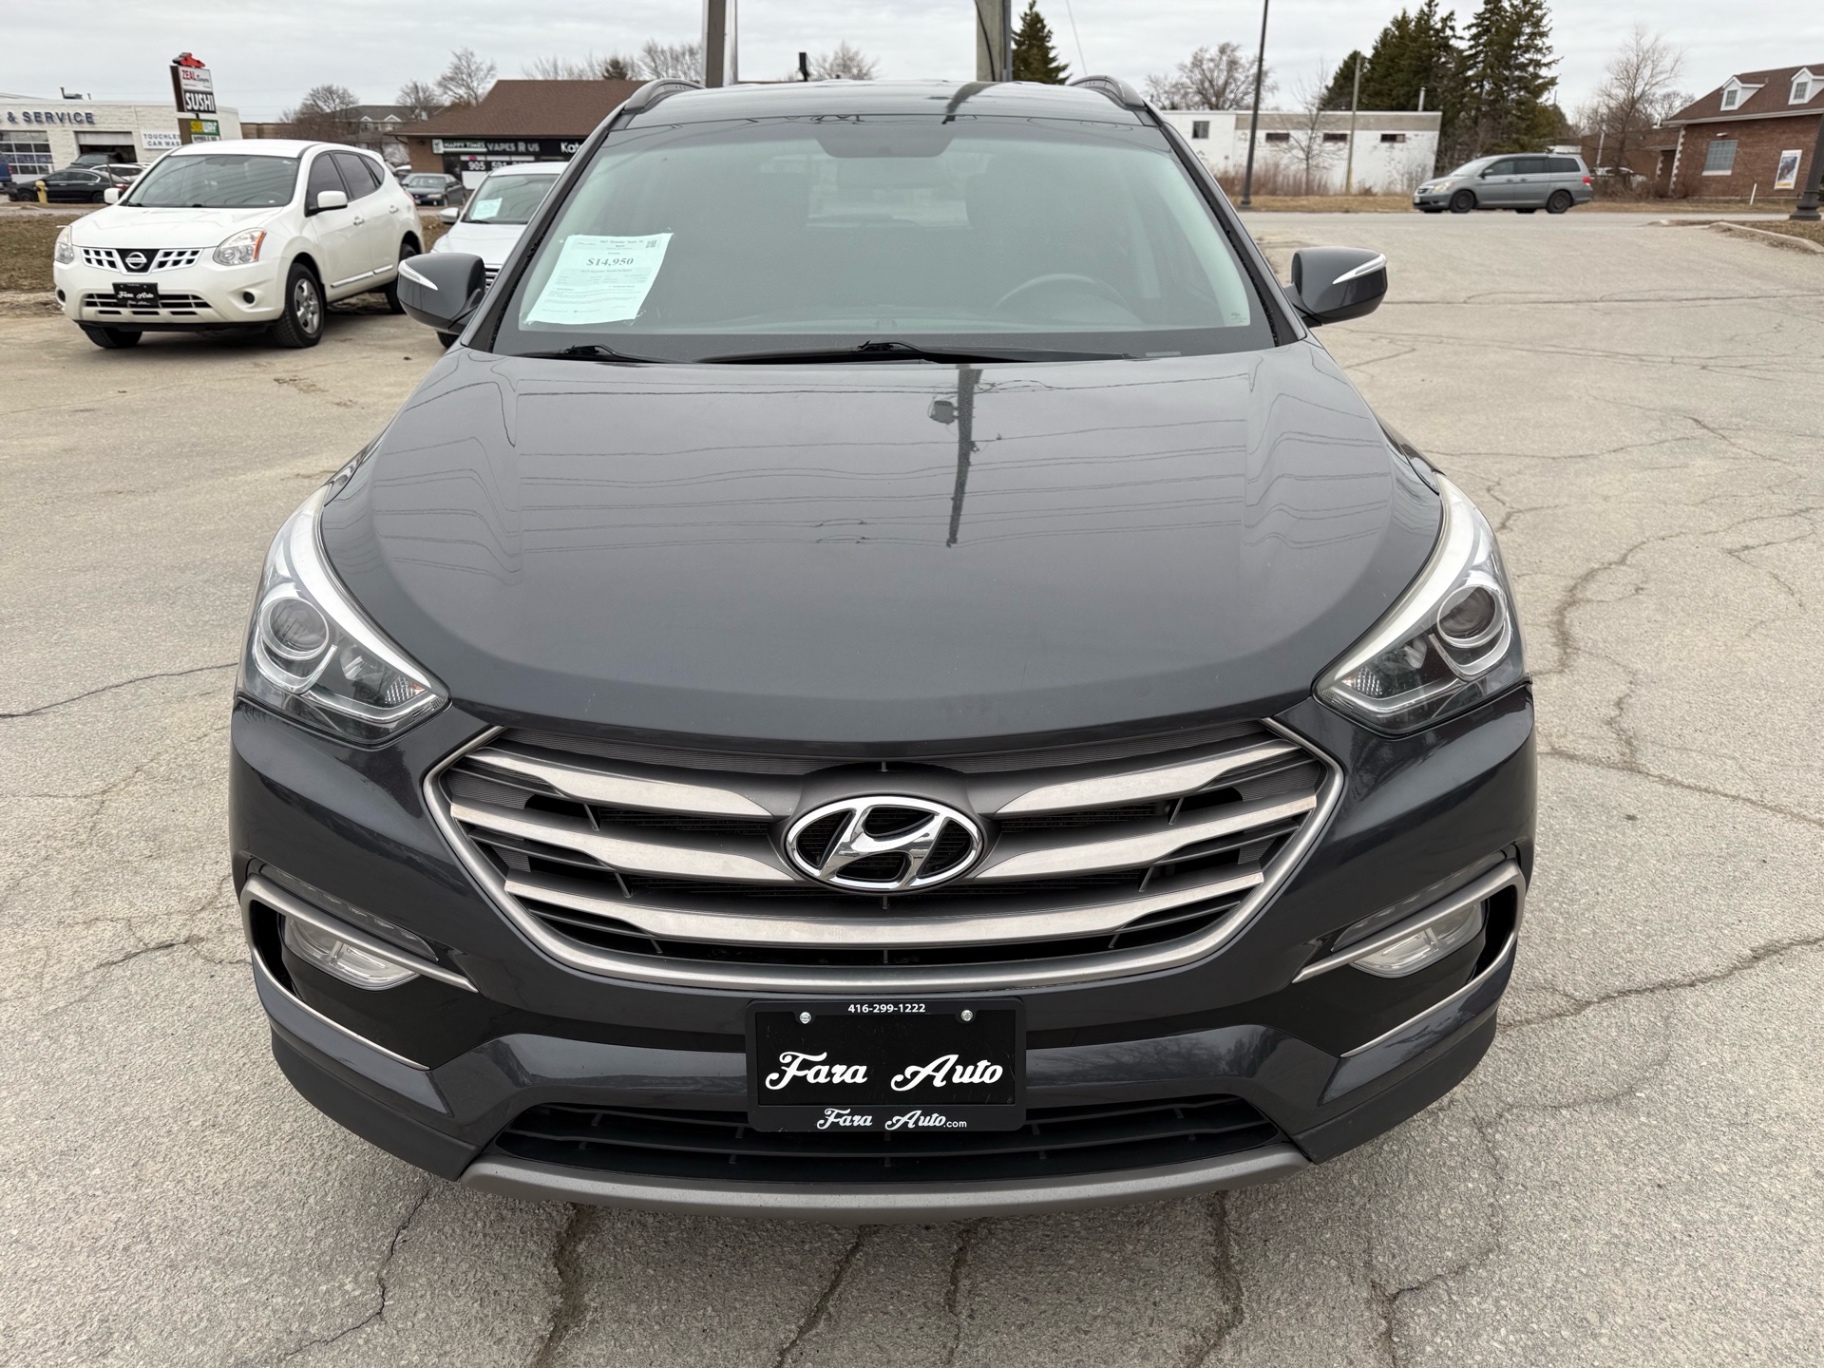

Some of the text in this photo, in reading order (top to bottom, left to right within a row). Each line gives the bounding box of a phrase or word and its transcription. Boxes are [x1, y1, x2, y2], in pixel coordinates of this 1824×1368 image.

[185, 92, 215, 112] SUSHI
[7, 111, 95, 125] & SERVICE
[487, 142, 516, 152] VAPES
[527, 142, 540, 152] US
[468, 161, 486, 170] 905
[586, 257, 634, 267] $14,950
[848, 1003, 926, 1014] 416-299-1222
[765, 1051, 1004, 1092] Fara Auto
[816, 1108, 967, 1131] Fara Auto.com
